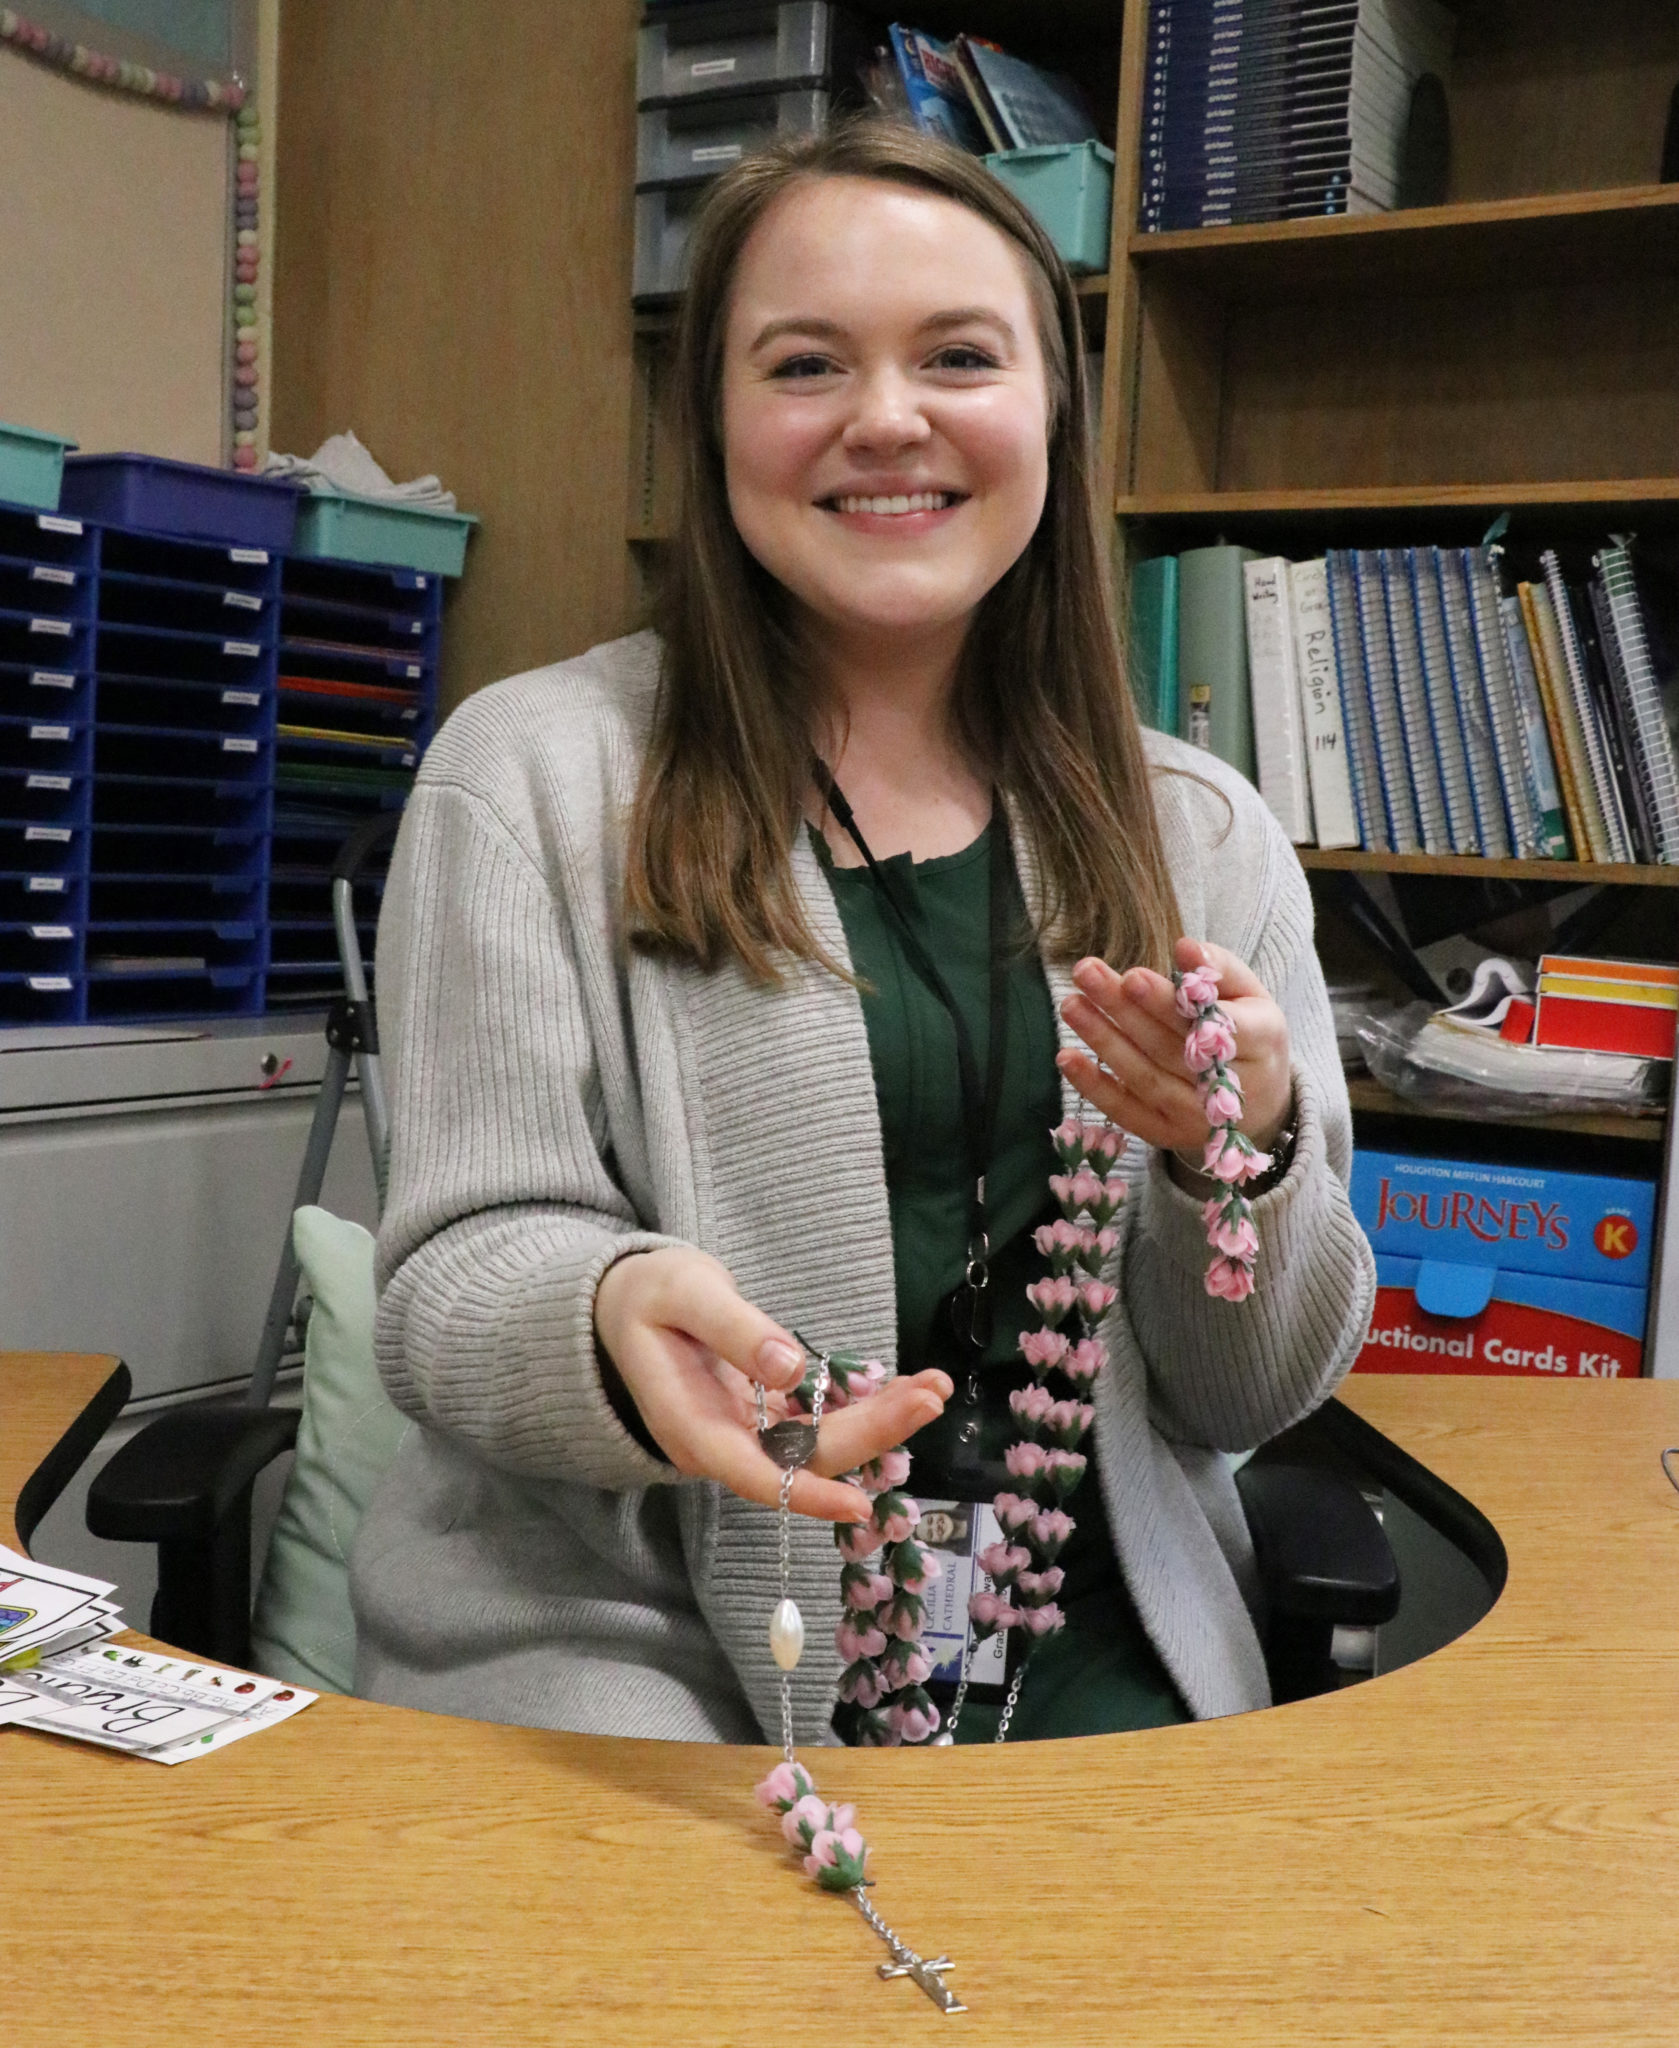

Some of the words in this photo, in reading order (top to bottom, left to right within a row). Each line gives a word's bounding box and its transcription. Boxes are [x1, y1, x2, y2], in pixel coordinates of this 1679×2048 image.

[1305, 629, 1332, 715] Religion
[1315, 732, 1337, 751] 114
[1394, 1163, 1450, 1179] HOUGHTON
[1452, 1169, 1490, 1183] MIFFLIN
[1492, 1174, 1546, 1189] HARCOURT
[1374, 1178, 1570, 1251] JOURNEYS
[1603, 1223, 1628, 1254] K
[1483, 1338, 1568, 1373] Cards
[1578, 1351, 1621, 1378] Kit
[942, 1561, 957, 1632] CATHEDRAL
